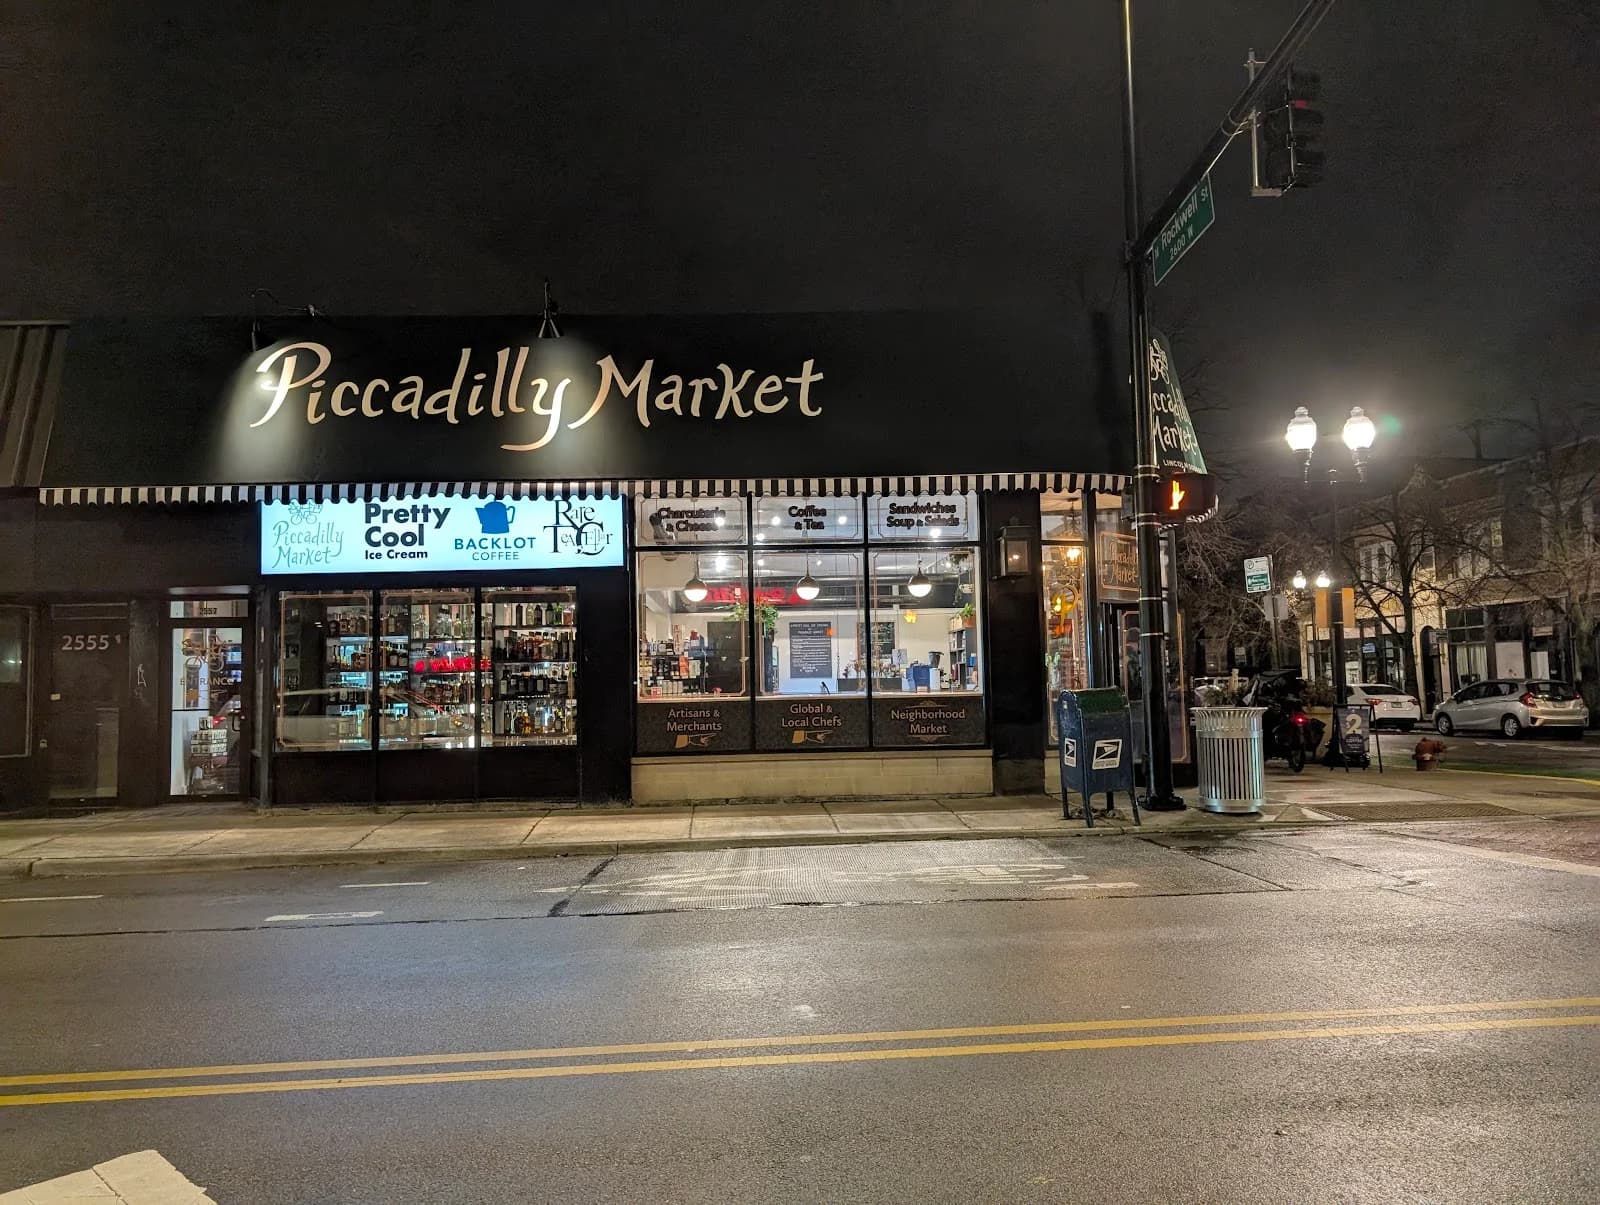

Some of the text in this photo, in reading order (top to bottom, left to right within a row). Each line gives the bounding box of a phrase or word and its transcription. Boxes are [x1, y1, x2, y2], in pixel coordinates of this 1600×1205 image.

[1161, 193, 1199, 250] Rockwell
[1201, 185, 1209, 201] St
[249, 341, 825, 452] Piccadilly Market
[788, 505, 828, 518] Coffee
[889, 502, 957, 515] Sandwiches
[364, 502, 451, 530] Pretty
[886, 515, 915, 529] Soup
[924, 515, 960, 527] Salads
[804, 518, 825, 530] Tea
[272, 520, 345, 557] Piccadilly
[364, 524, 424, 548] Cool
[454, 536, 537, 551] BACKLOT
[272, 545, 332, 569] Market
[364, 549, 429, 560] Ice Cream
[472, 551, 520, 561] COFFEE
[61, 634, 110, 650] 2555
[181, 676, 234, 686] ENTRANCE
[668, 707, 720, 718] Artisans &
[789, 703, 833, 714] Global &
[890, 708, 966, 722] Neighborhood
[666, 719, 722, 732] Merchants
[781, 715, 843, 728] Local Chefs
[909, 722, 947, 734] Market
